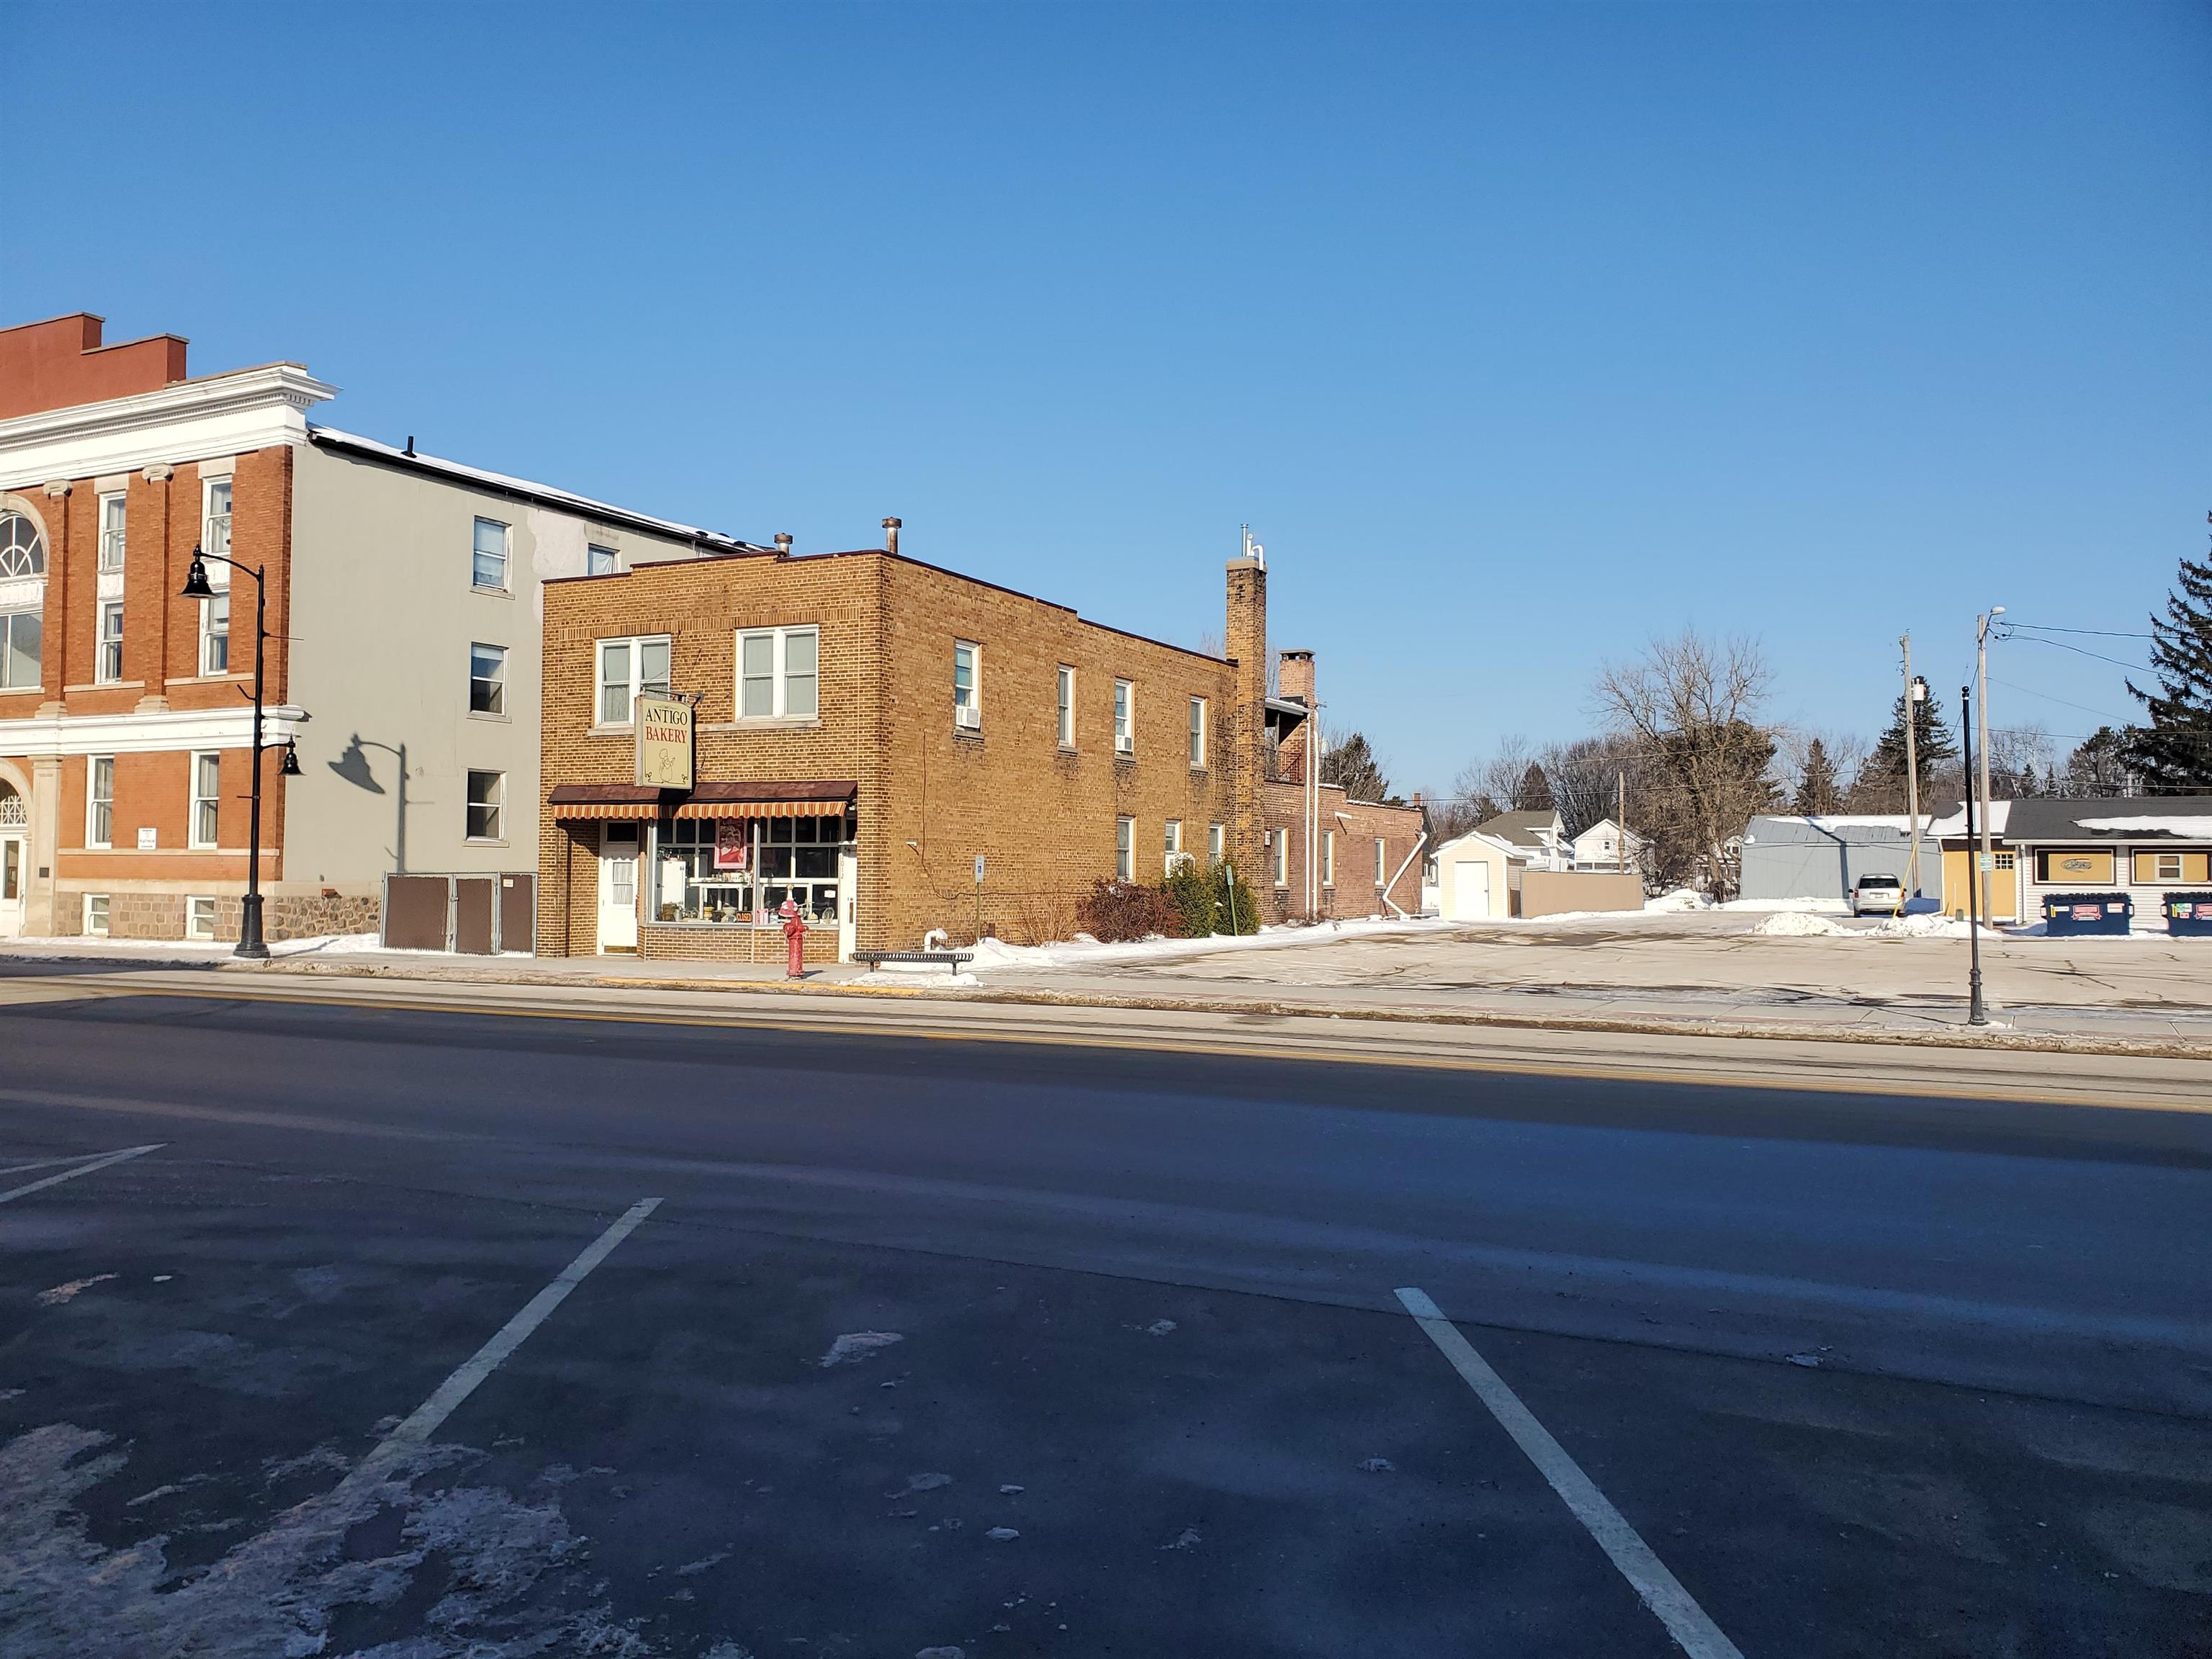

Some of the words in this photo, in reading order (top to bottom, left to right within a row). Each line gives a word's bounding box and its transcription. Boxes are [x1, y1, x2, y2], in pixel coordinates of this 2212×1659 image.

[645, 708, 688, 725] ANTIGO
[645, 726, 688, 744] BAKERY
[737, 912, 752, 922] CLOSED
